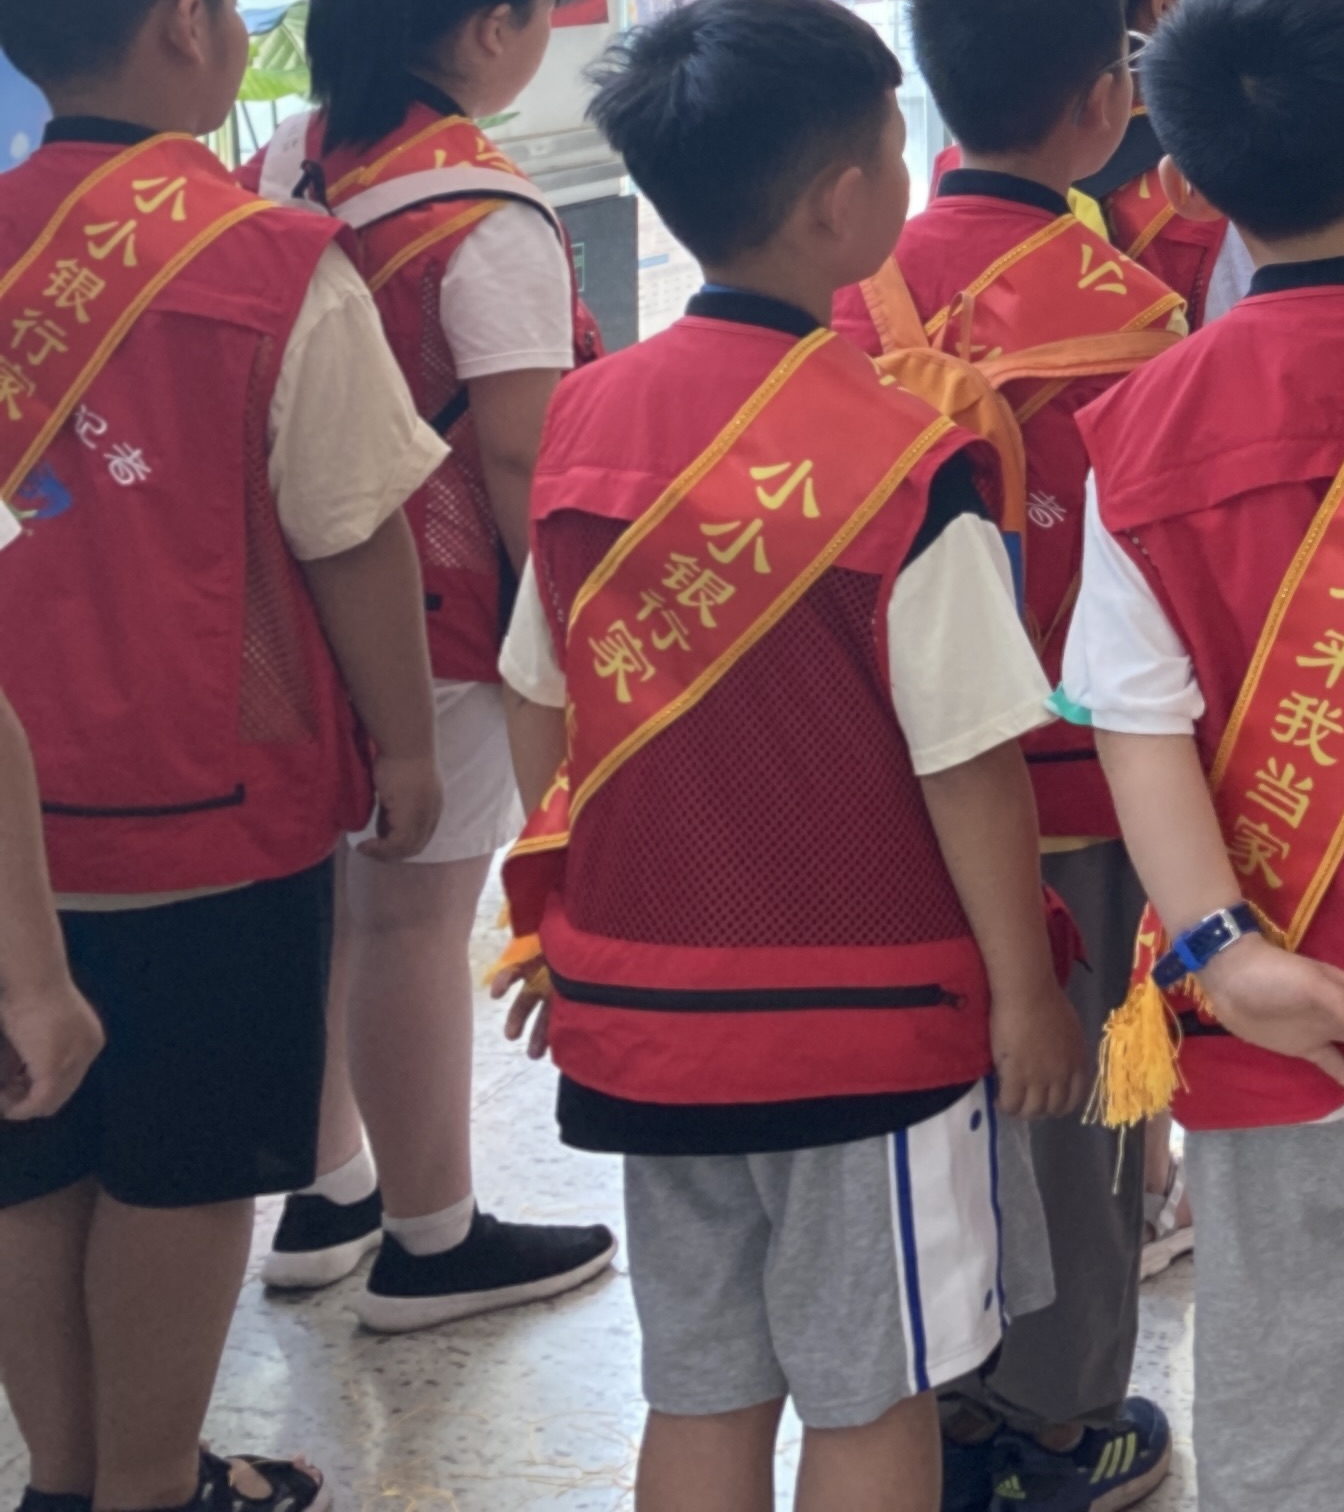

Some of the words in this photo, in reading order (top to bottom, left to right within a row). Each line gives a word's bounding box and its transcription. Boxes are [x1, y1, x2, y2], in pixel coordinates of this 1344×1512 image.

[587, 459, 820, 704] 小小银行家
